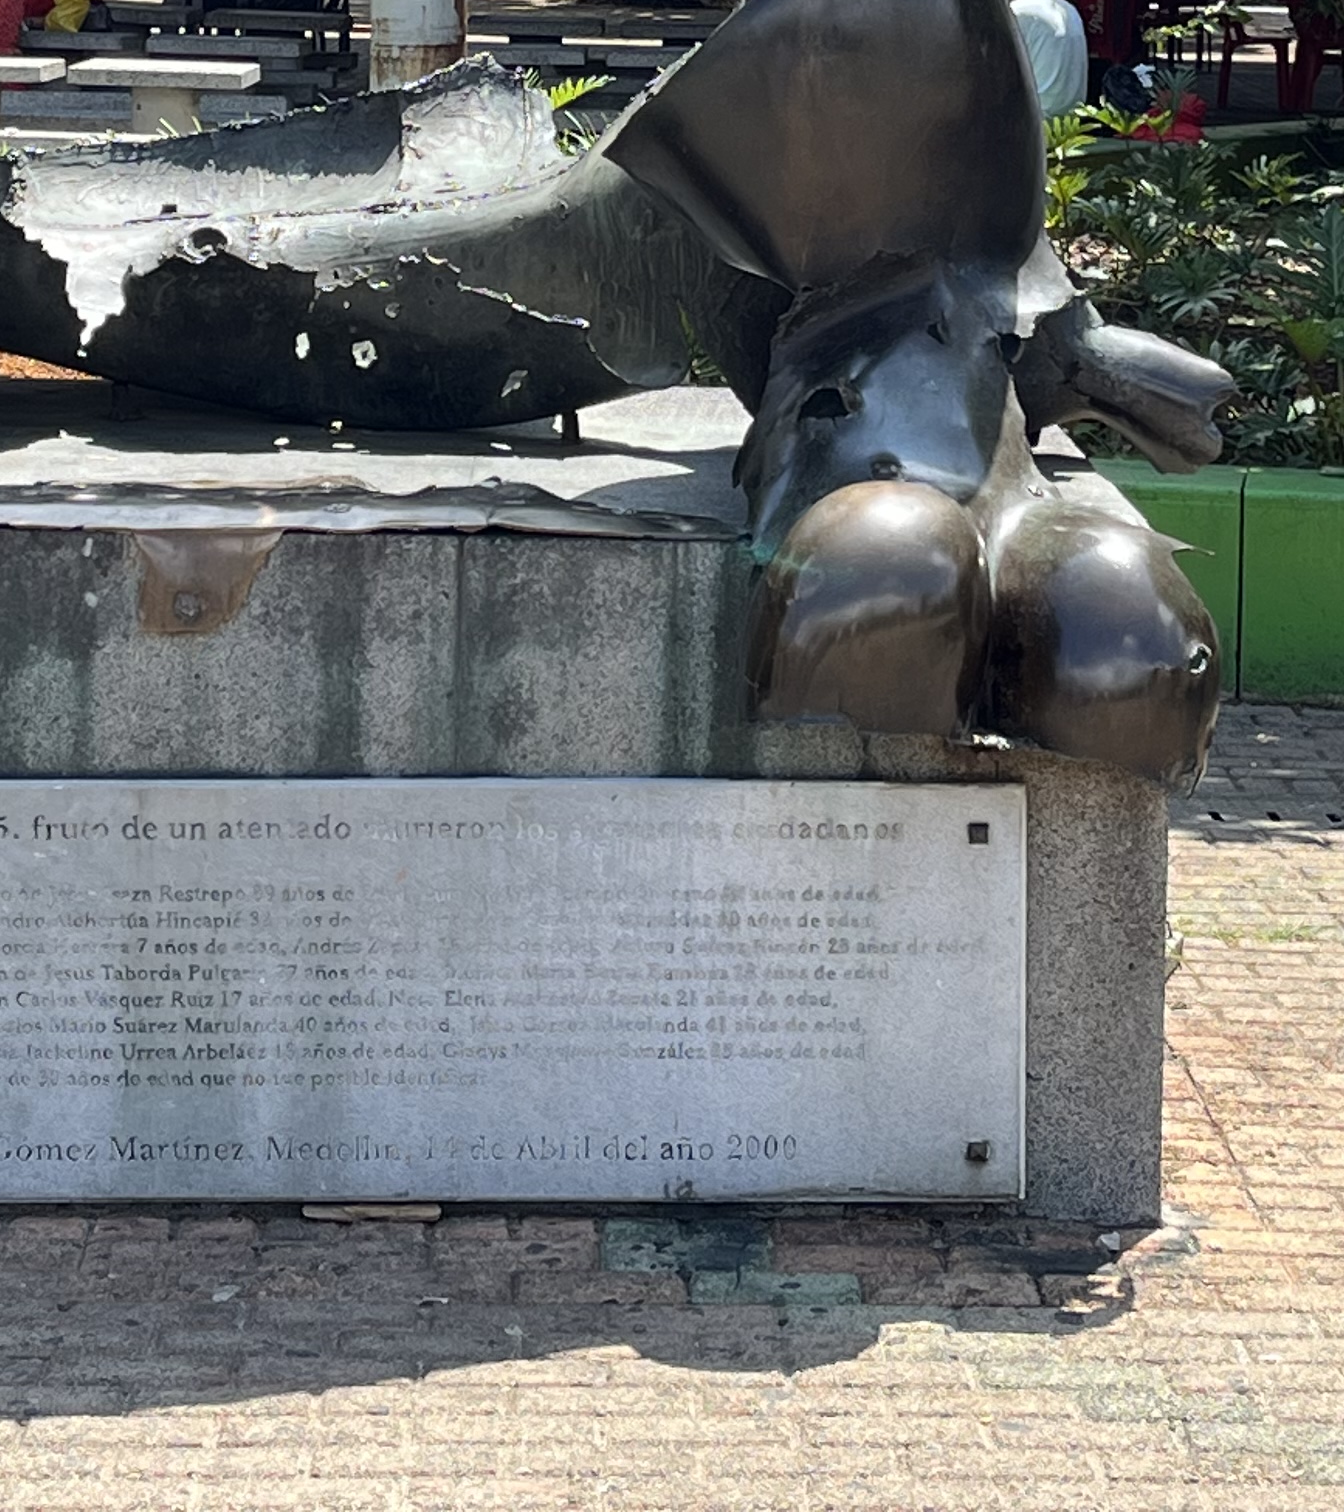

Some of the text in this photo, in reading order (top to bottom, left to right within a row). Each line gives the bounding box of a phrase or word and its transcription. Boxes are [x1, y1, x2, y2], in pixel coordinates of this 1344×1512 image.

[31, 814, 109, 842] fruto
[121, 814, 158, 842] de
[168, 819, 207, 842] un
[217, 814, 352, 841] atentado
[158, 885, 247, 906] Restrepo
[155, 908, 241, 932] Hincapié
[137, 937, 148, 954] 7
[154, 935, 198, 955] años
[101, 963, 182, 982] Taborda
[220, 989, 244, 1009] 17
[111, 1015, 178, 1034] Suárez
[183, 1015, 287, 1035] Marulanda
[118, 1042, 178, 1061] Urrea
[183, 1040, 266, 1061] Arbeláez
[301, 1041, 347, 1061] años
[352, 1041, 376, 1061] de
[200, 1070, 237, 1093] que
[469, 1135, 505, 1160] de
[515, 1134, 592, 1160] Abril
[602, 1134, 649, 1161] del
[659, 1136, 715, 1161] año
[727, 1134, 798, 1161] 2000
